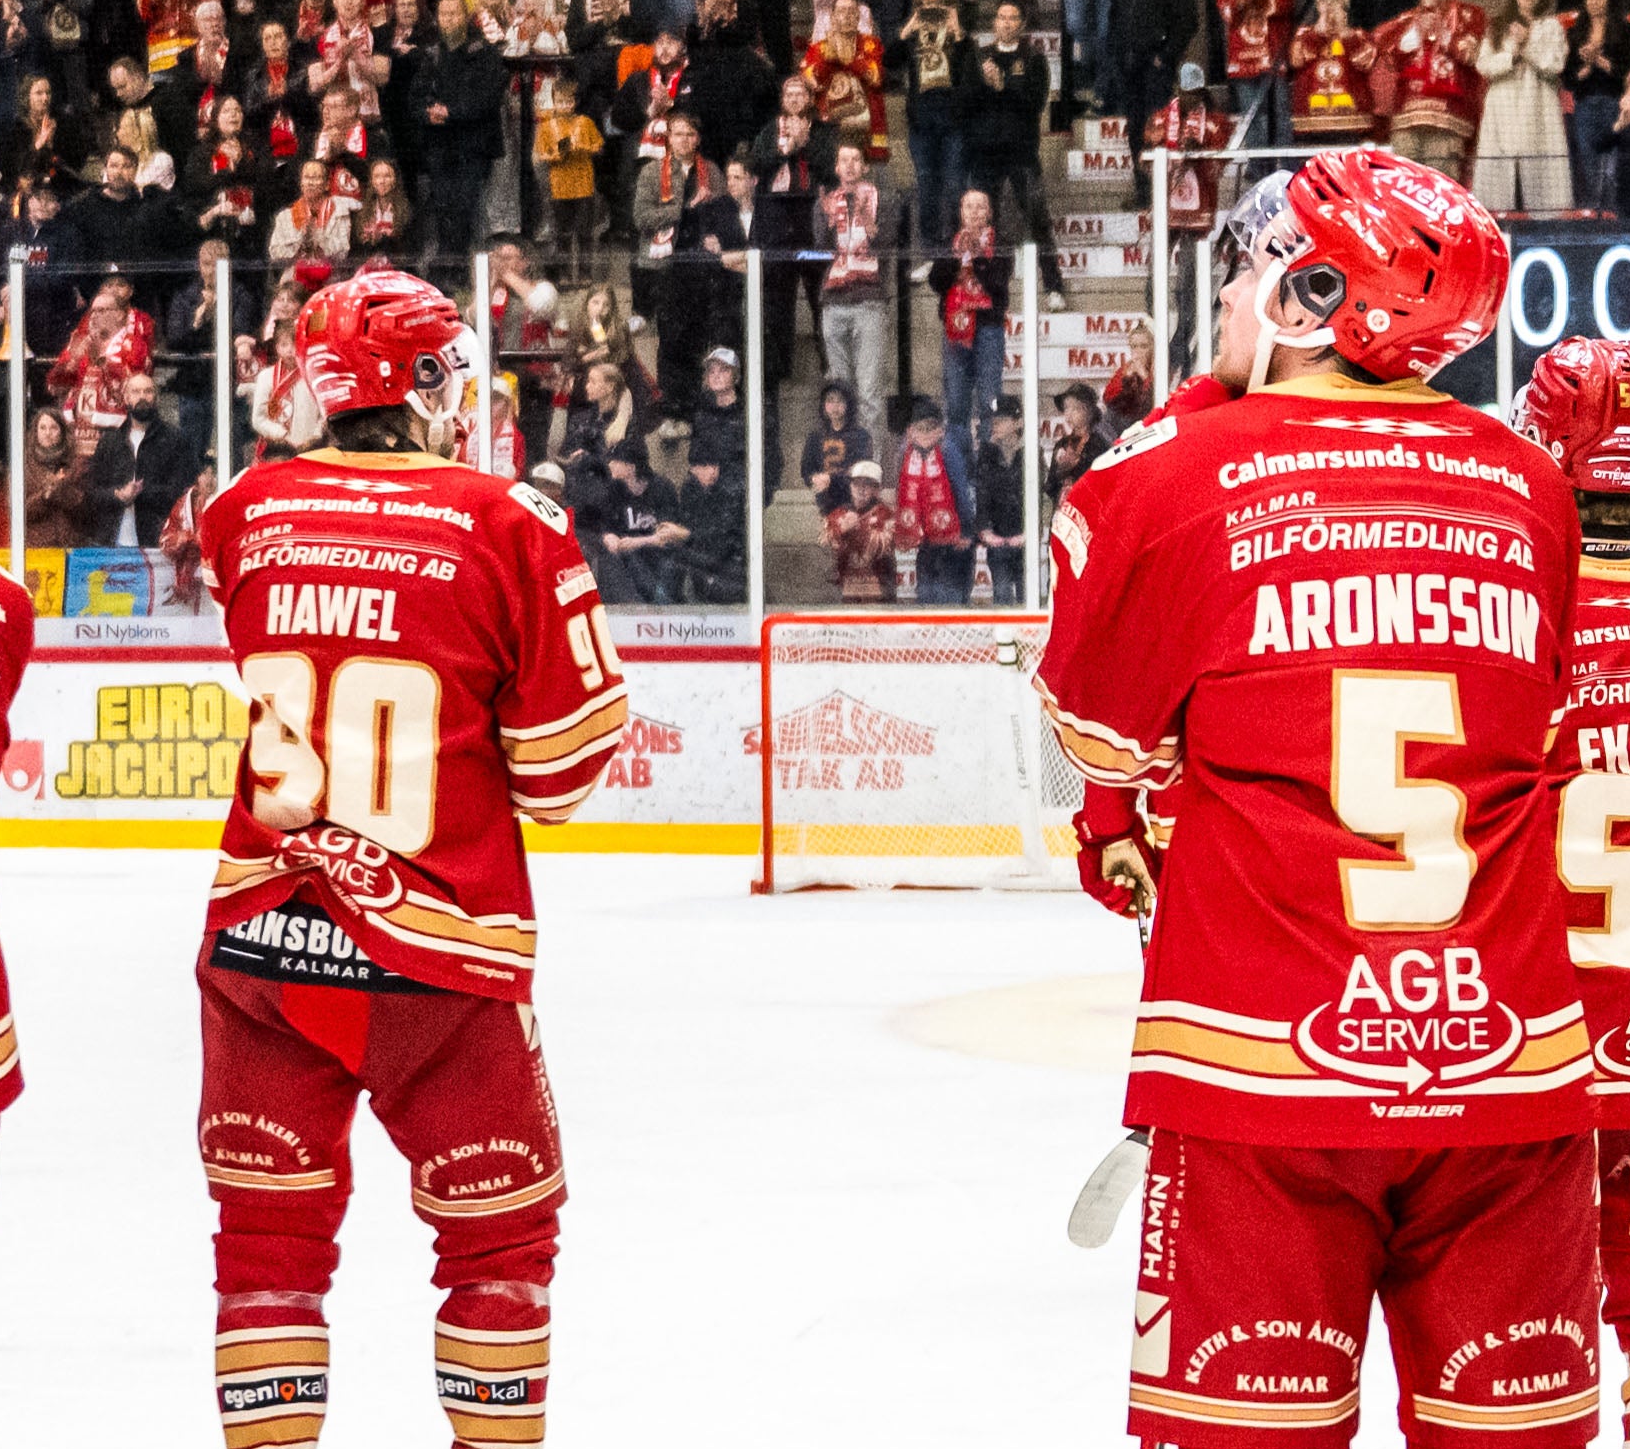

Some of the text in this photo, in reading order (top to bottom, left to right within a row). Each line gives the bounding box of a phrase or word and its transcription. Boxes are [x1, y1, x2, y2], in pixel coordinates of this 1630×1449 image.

[1083, 151, 1133, 171] MAX
[1218, 444, 1531, 500] Calmarsunds Undertak
[245, 497, 475, 532] Calmarsunds Undertak
[1224, 491, 1317, 529] KALMAR
[1230, 517, 1498, 572] BILFÖRMEDLING
[420, 558, 458, 582] AB
[105, 621, 171, 642] Nybloms
[266, 583, 402, 642] HAWEL
[667, 620, 736, 641] Nybloms
[1248, 573, 1539, 665] ARONSSON
[97, 682, 227, 741] EURO
[1331, 667, 1480, 932] 5
[279, 955, 370, 980] KALMAR
[1337, 946, 1489, 1015] AGB
[1336, 1015, 1490, 1054] SERVICE
[1142, 1172, 1171, 1281] HAMN
[1184, 1337, 1229, 1384] KEITH
[1230, 1324, 1251, 1343] &
[1255, 1320, 1301, 1342] SON
[1438, 1317, 1547, 1392] KEITH & SON
[223, 1372, 328, 1409] egenlokal
[1235, 1372, 1329, 1395] KALMAR
[1492, 1369, 1570, 1397] KALMAR
